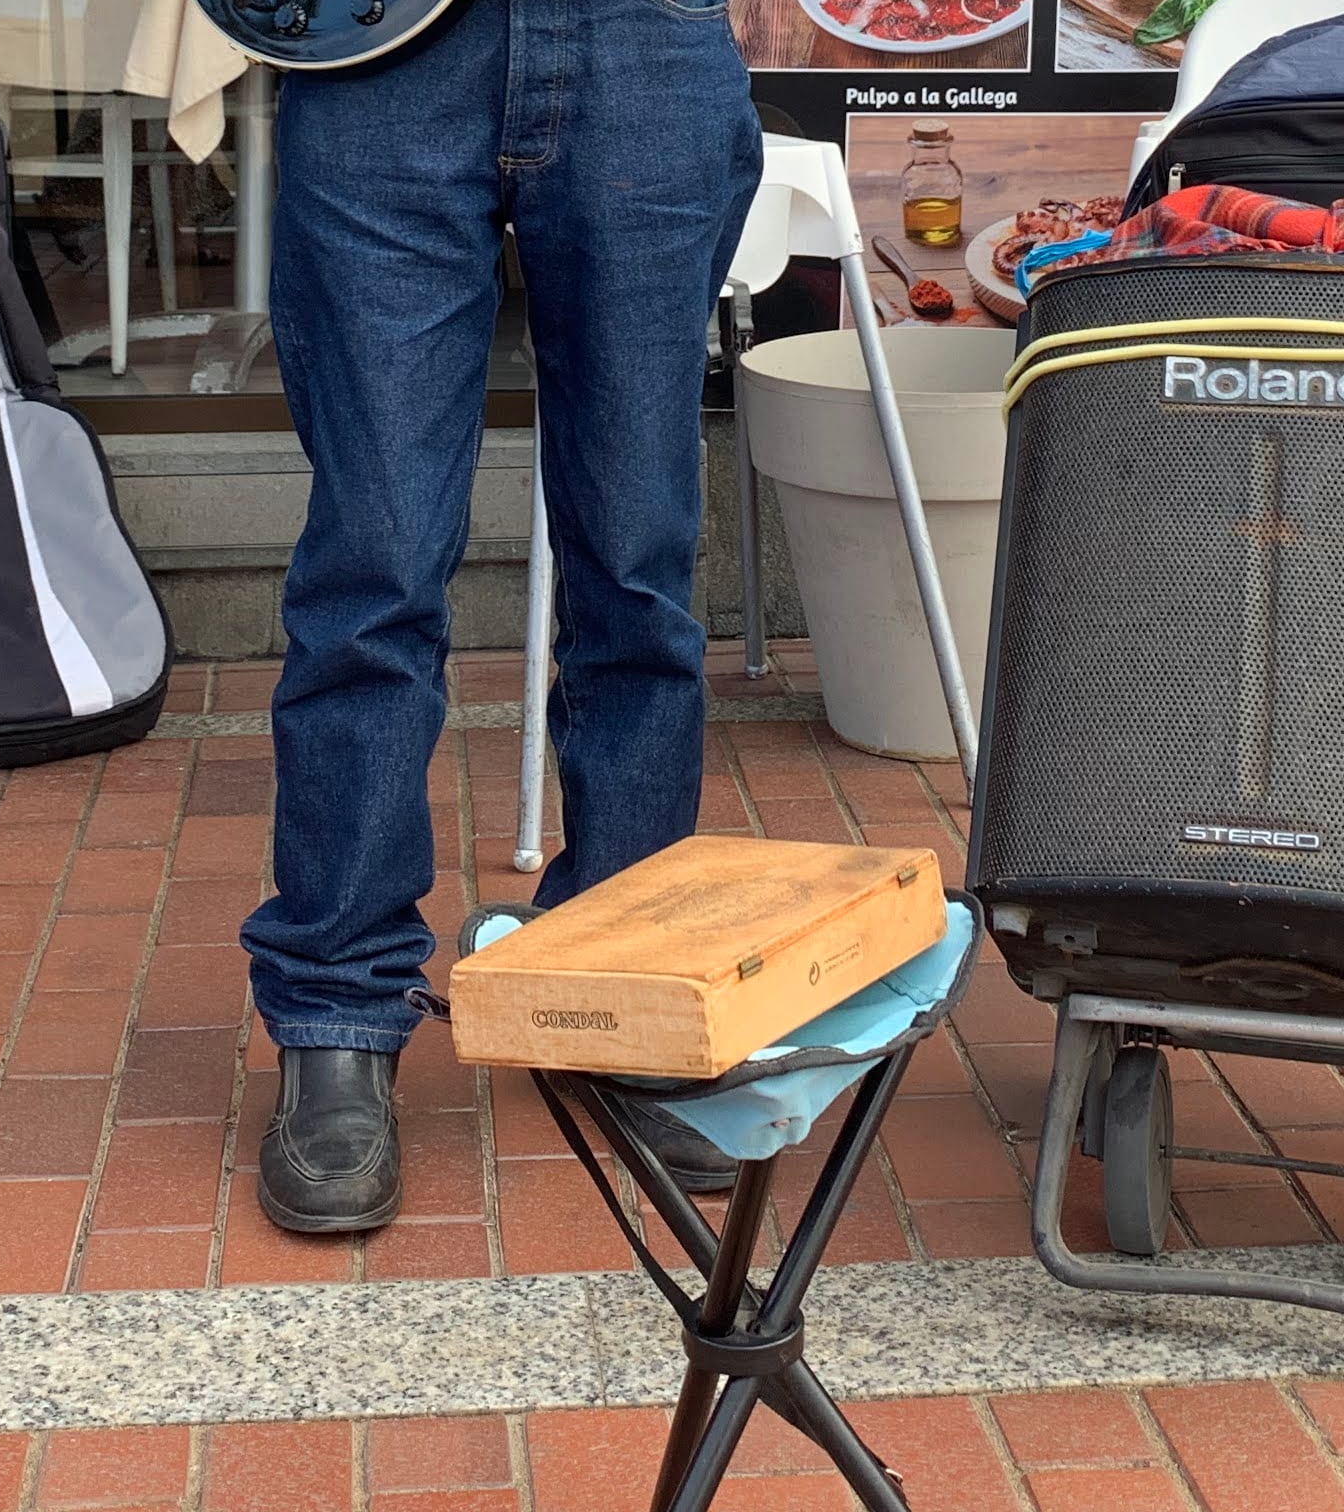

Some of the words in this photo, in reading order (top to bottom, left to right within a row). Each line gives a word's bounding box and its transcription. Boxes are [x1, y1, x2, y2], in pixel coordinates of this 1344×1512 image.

[846, 87, 899, 109] Pulpo
[904, 91, 916, 105] a
[922, 87, 940, 105] la
[945, 87, 1018, 109] Gallega
[1185, 826, 1320, 848] STEREO
